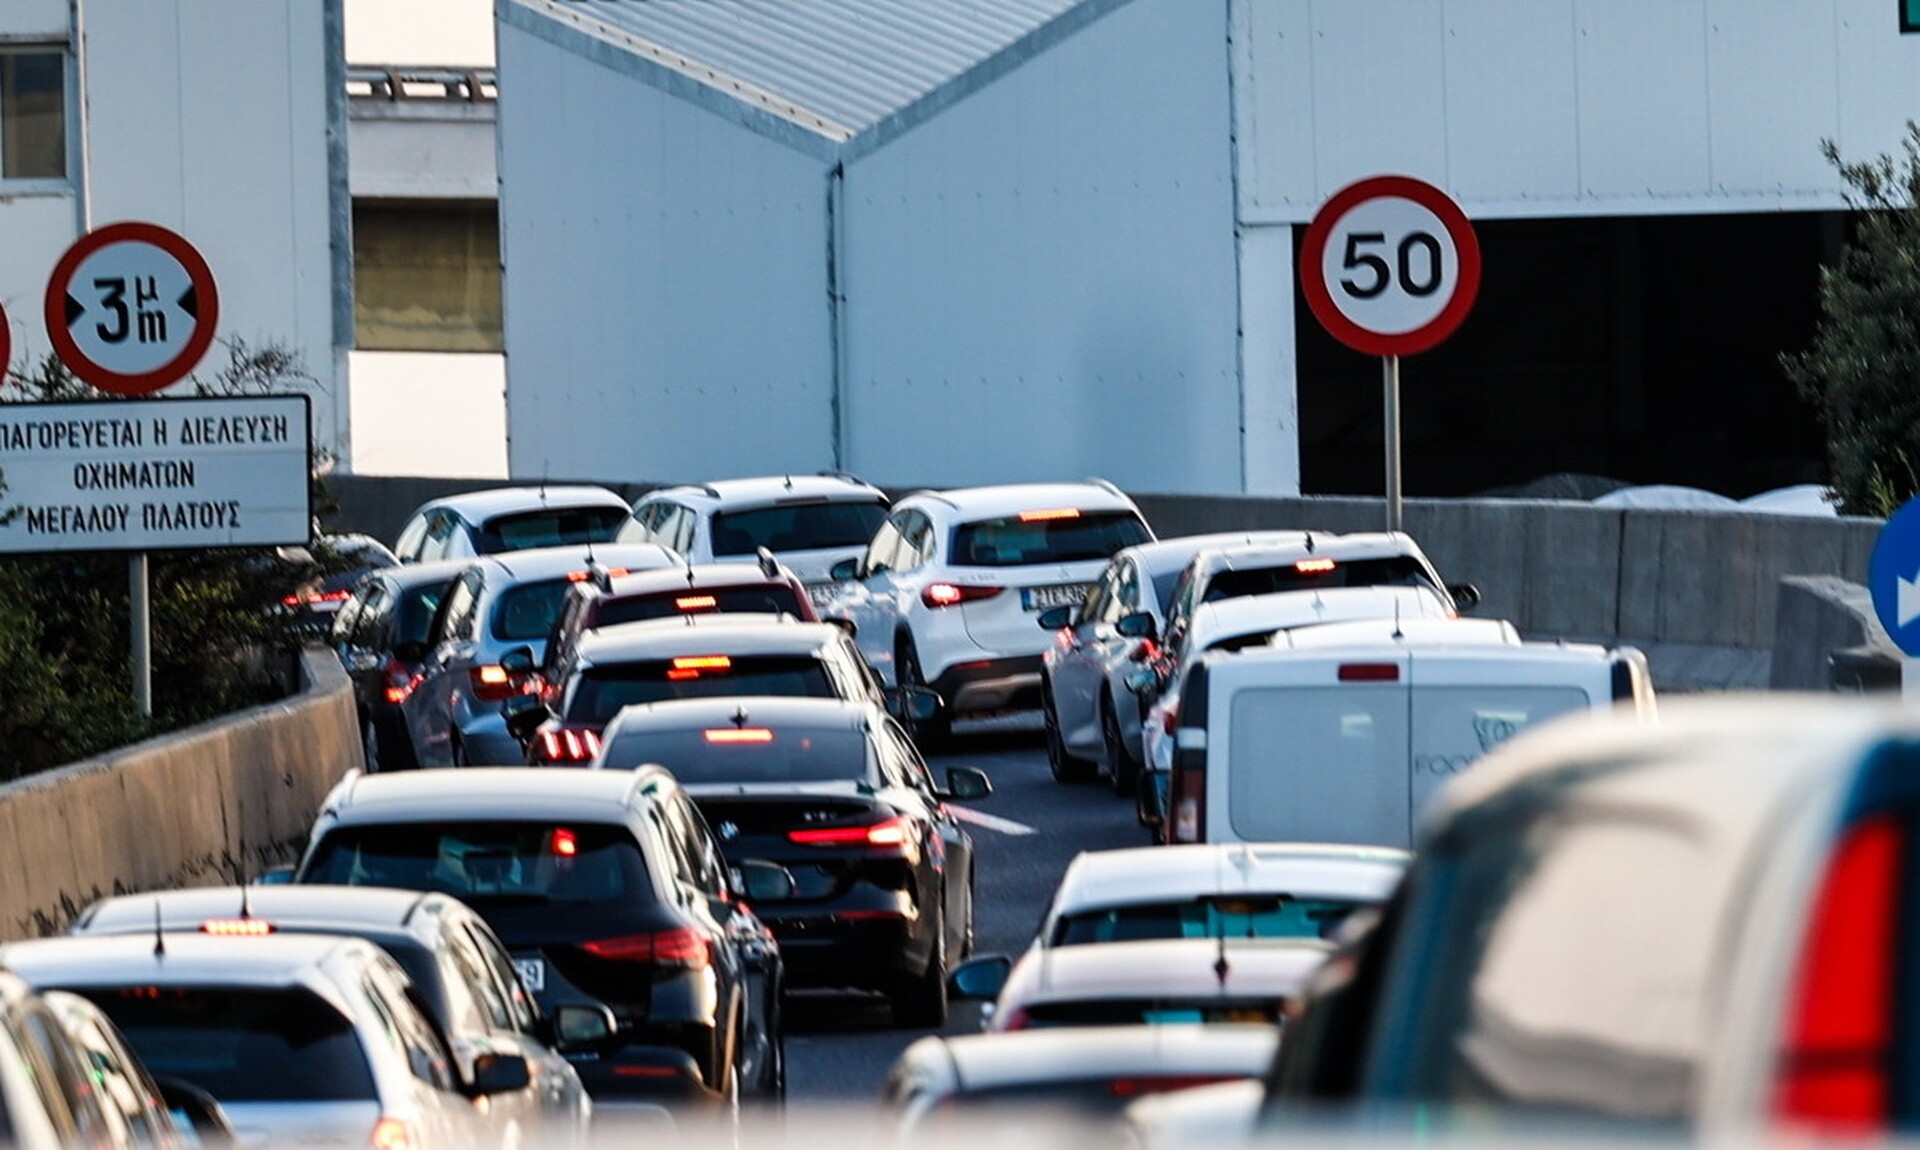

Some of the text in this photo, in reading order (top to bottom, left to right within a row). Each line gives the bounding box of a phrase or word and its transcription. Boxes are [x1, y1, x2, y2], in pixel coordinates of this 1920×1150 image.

[1341, 231, 1442, 299] 50
[94, 276, 129, 344] 3
[153, 418, 167, 446] Η
[181, 415, 287, 445] ΔΙΕΛΕΥΣΗ
[74, 460, 194, 490] ΟΧΗΜΑΤΩΝ
[27, 501, 241, 534] ΜΕΓΑΛΟΥ ΠΛΑΤΟΥΣ
